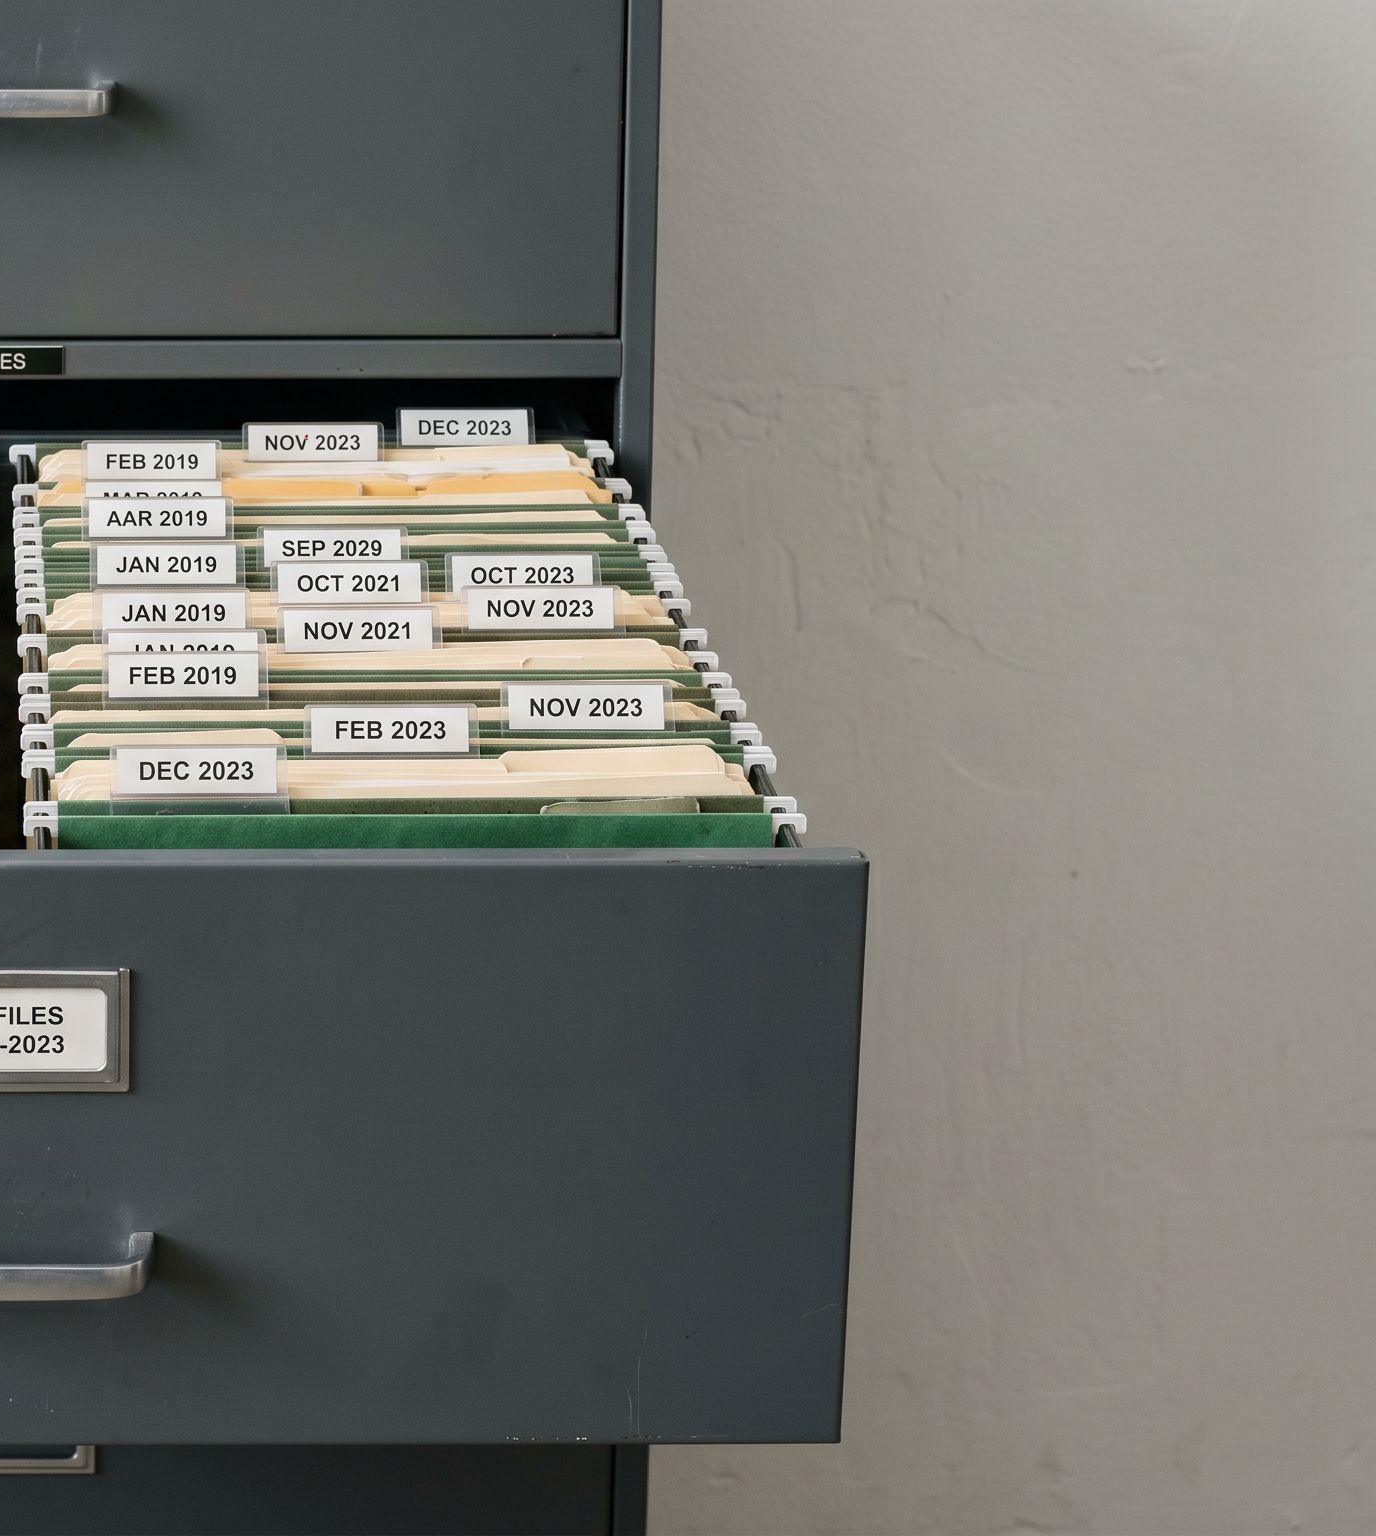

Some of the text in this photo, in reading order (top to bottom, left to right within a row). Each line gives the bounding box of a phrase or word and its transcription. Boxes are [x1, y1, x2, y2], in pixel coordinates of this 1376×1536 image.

[419, 420, 511, 435] DEC 2023
[266, 435, 360, 450] NOV 2023
[107, 454, 198, 469] FEB 2019
[107, 511, 207, 526] AAR 2019
[282, 540, 382, 557] SEP 2029
[116, 556, 216, 573] JAN 2019
[298, 575, 398, 592] OCT 2021
[471, 567, 574, 584] OCT 2023
[122, 604, 225, 622] JAN 2019
[488, 600, 593, 617] NOV 2023
[305, 622, 410, 640] NOV 2021
[130, 667, 236, 684] FEB 2019
[530, 698, 642, 717] NOV 2023
[336, 721, 446, 739] FEB 2023
[140, 761, 253, 780] DEC 2023
